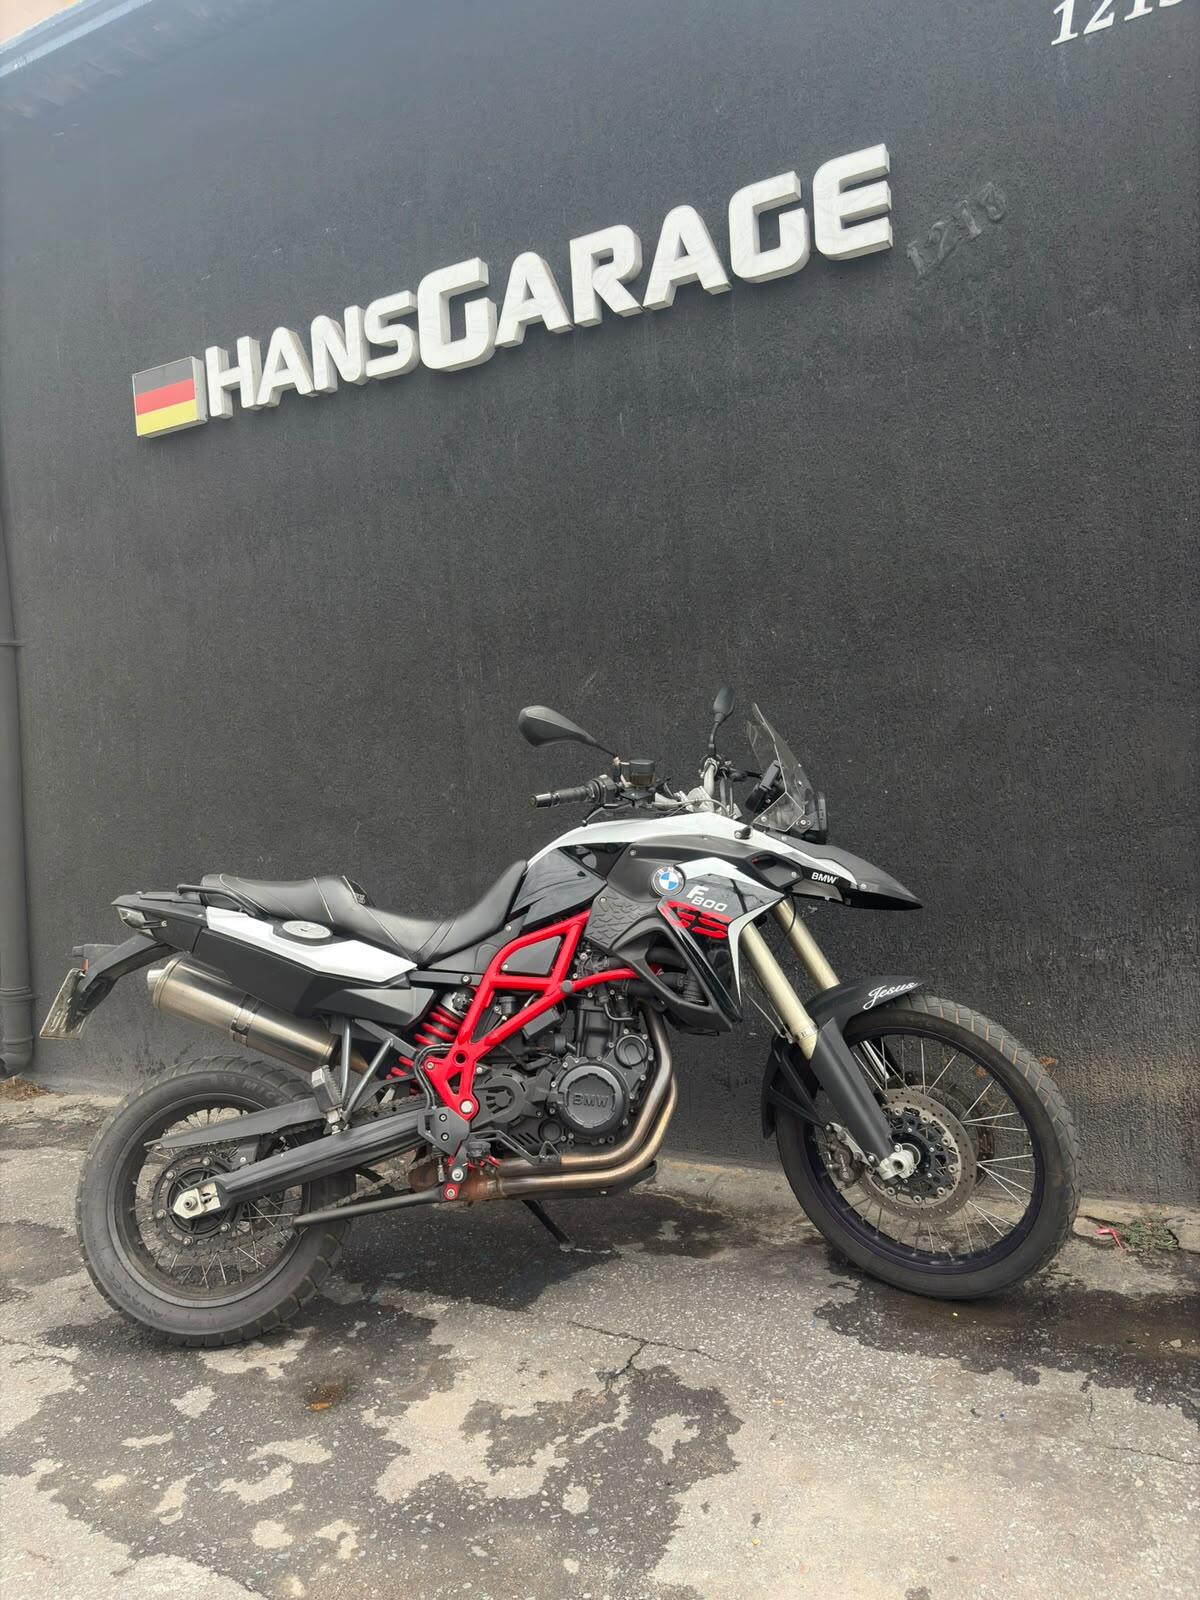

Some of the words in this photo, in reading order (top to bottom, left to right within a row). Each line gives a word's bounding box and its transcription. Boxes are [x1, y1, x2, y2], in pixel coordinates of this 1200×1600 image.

[1051, 0, 1182, 46] 12
[811, 871, 838, 884] BMW
[686, 885, 709, 899] F
[691, 896, 727, 912] 800
[863, 982, 918, 1010] Jesus
[573, 1092, 609, 1107] BMW
